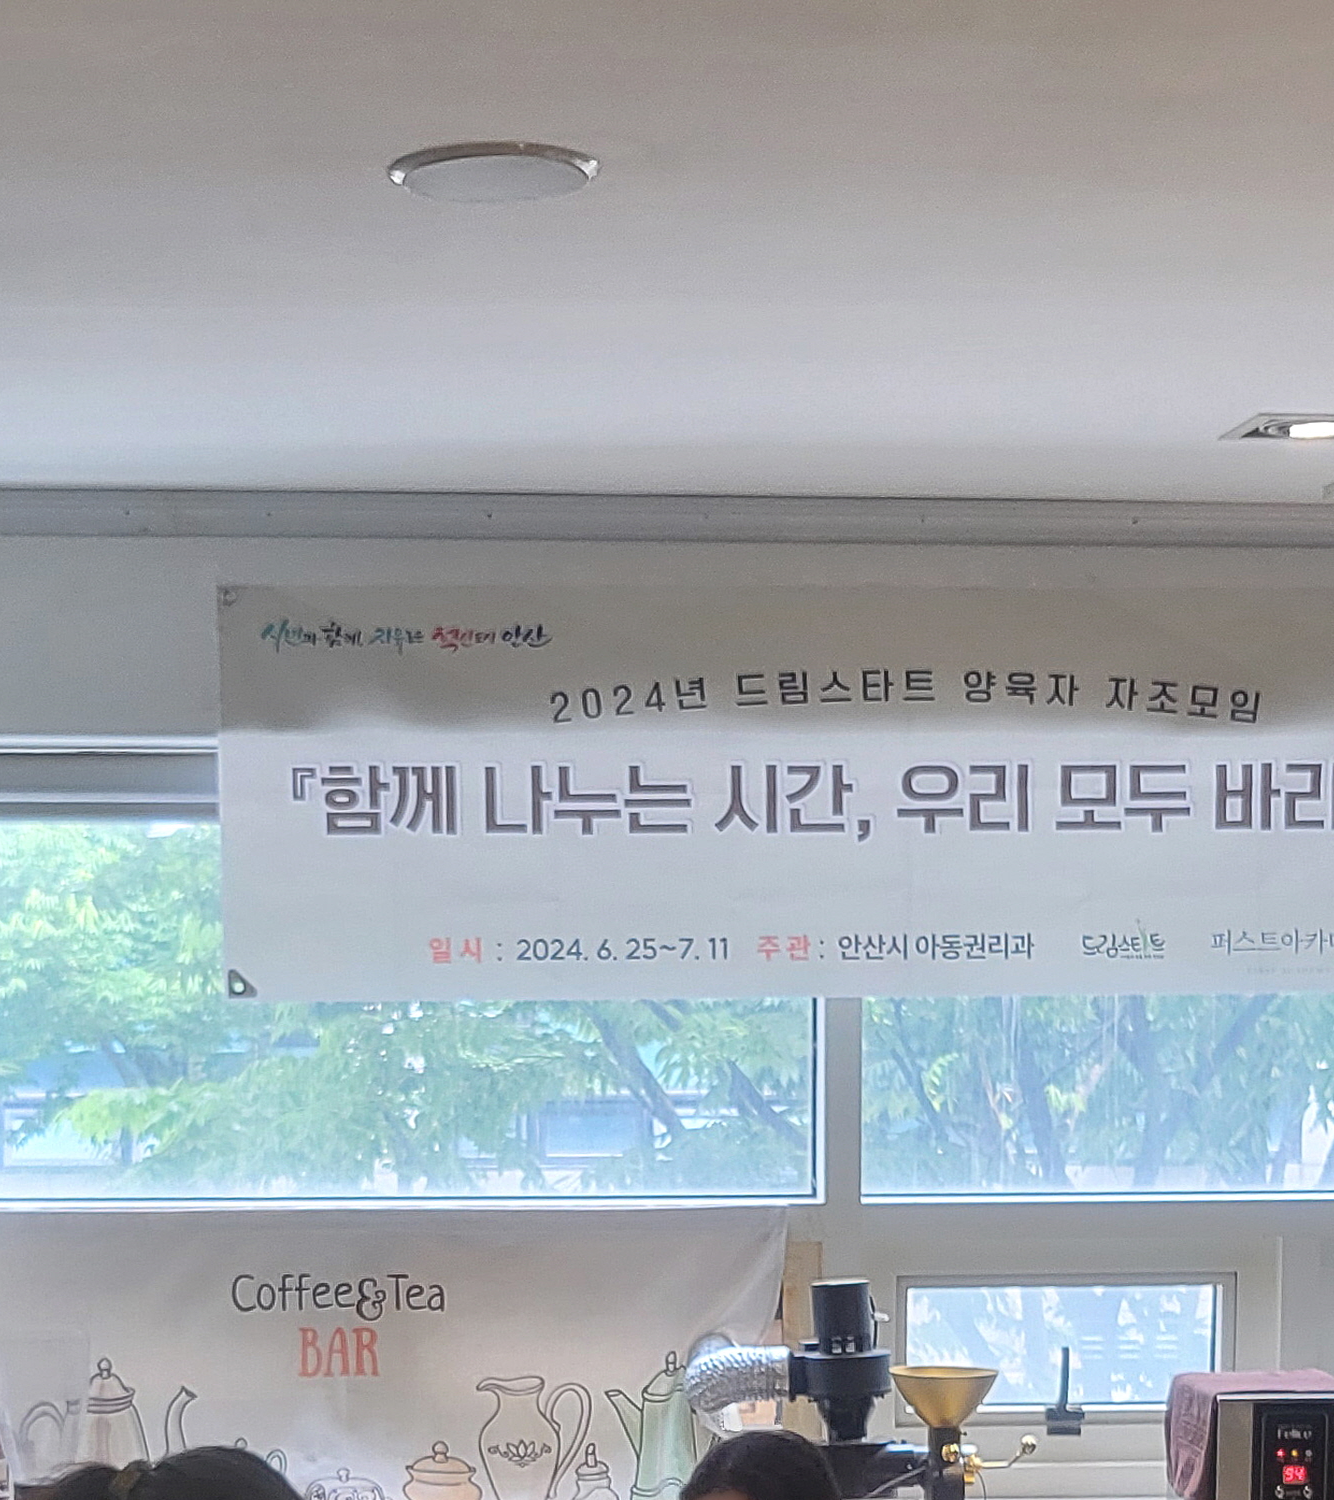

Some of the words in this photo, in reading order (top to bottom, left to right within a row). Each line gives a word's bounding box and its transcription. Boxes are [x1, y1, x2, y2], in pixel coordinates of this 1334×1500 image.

[549, 676, 707, 724] 2024년
[736, 669, 936, 707] 드림스타트
[963, 670, 1079, 706] 양육자
[1105, 674, 1261, 724] 자조모임
[483, 764, 693, 835] 나누는
[714, 763, 872, 843] 시간,
[897, 762, 1030, 833] 우리
[1055, 762, 1191, 832] 모두
[837, 933, 909, 962] 안산시
[915, 932, 1035, 961] 아동권리과
[297, 1325, 381, 1378] BAR
